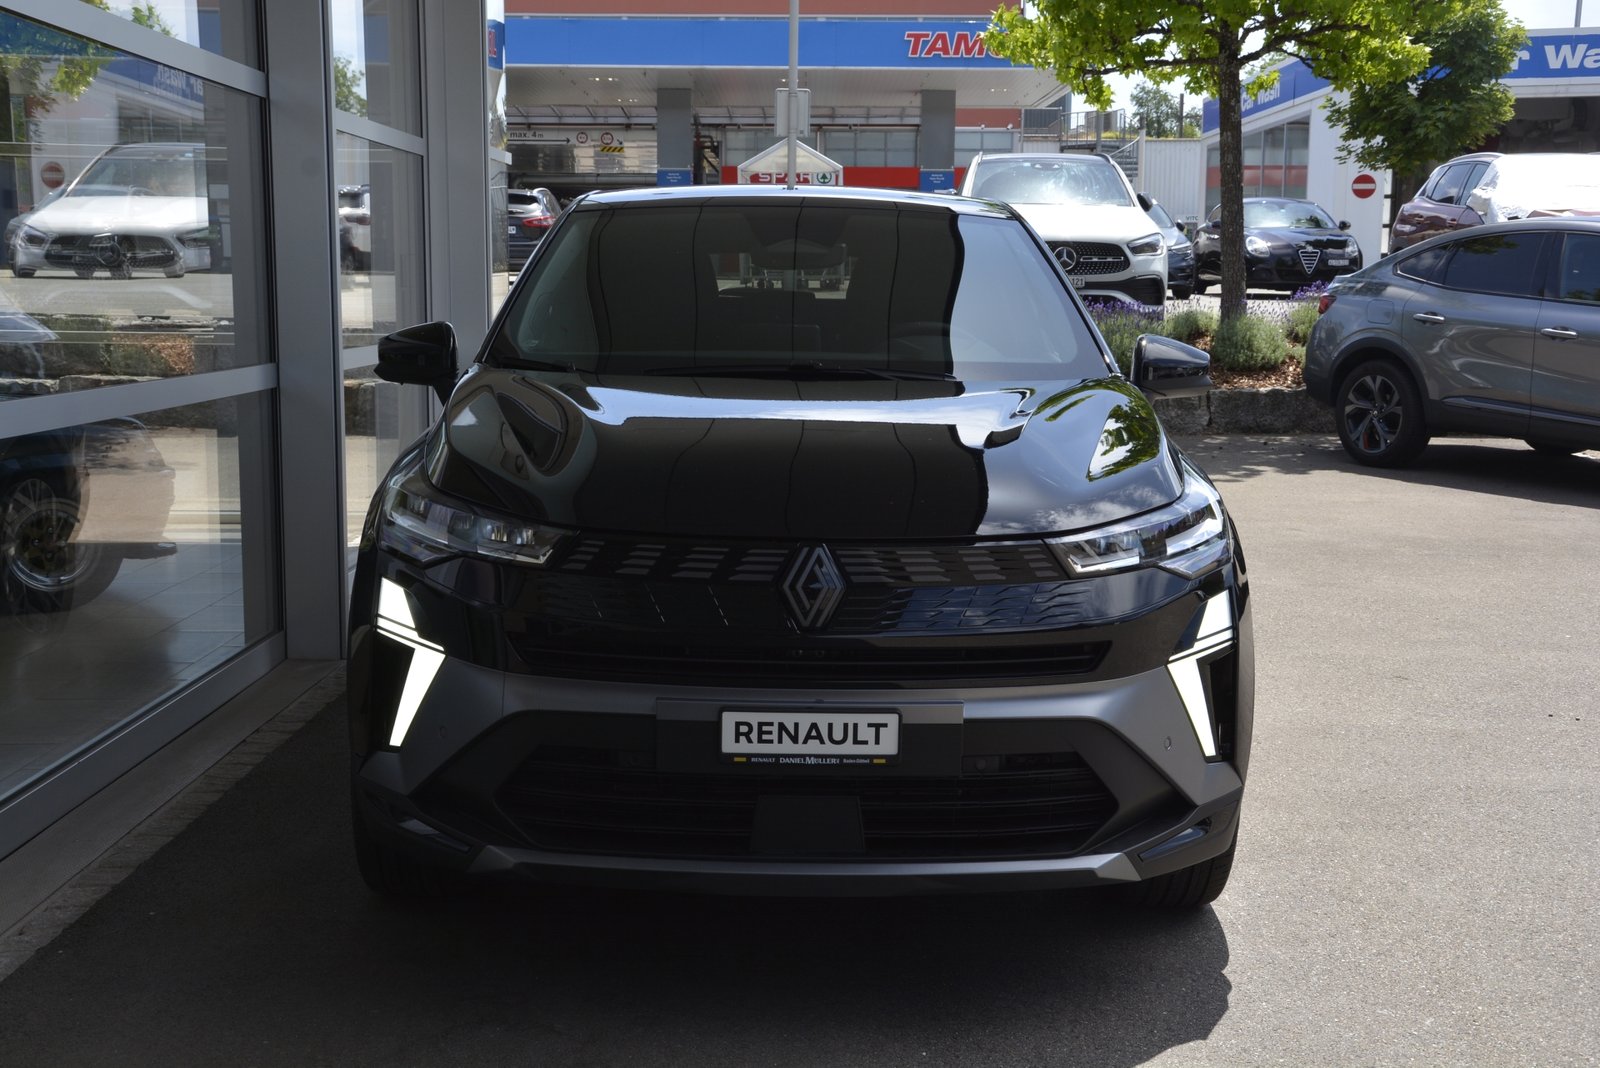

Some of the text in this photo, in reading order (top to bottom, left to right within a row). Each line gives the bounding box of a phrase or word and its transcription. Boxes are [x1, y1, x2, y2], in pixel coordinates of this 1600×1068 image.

[904, 31, 1003, 58] TAM
[758, 172, 810, 183] SPR
[734, 721, 888, 745] RENAULT
